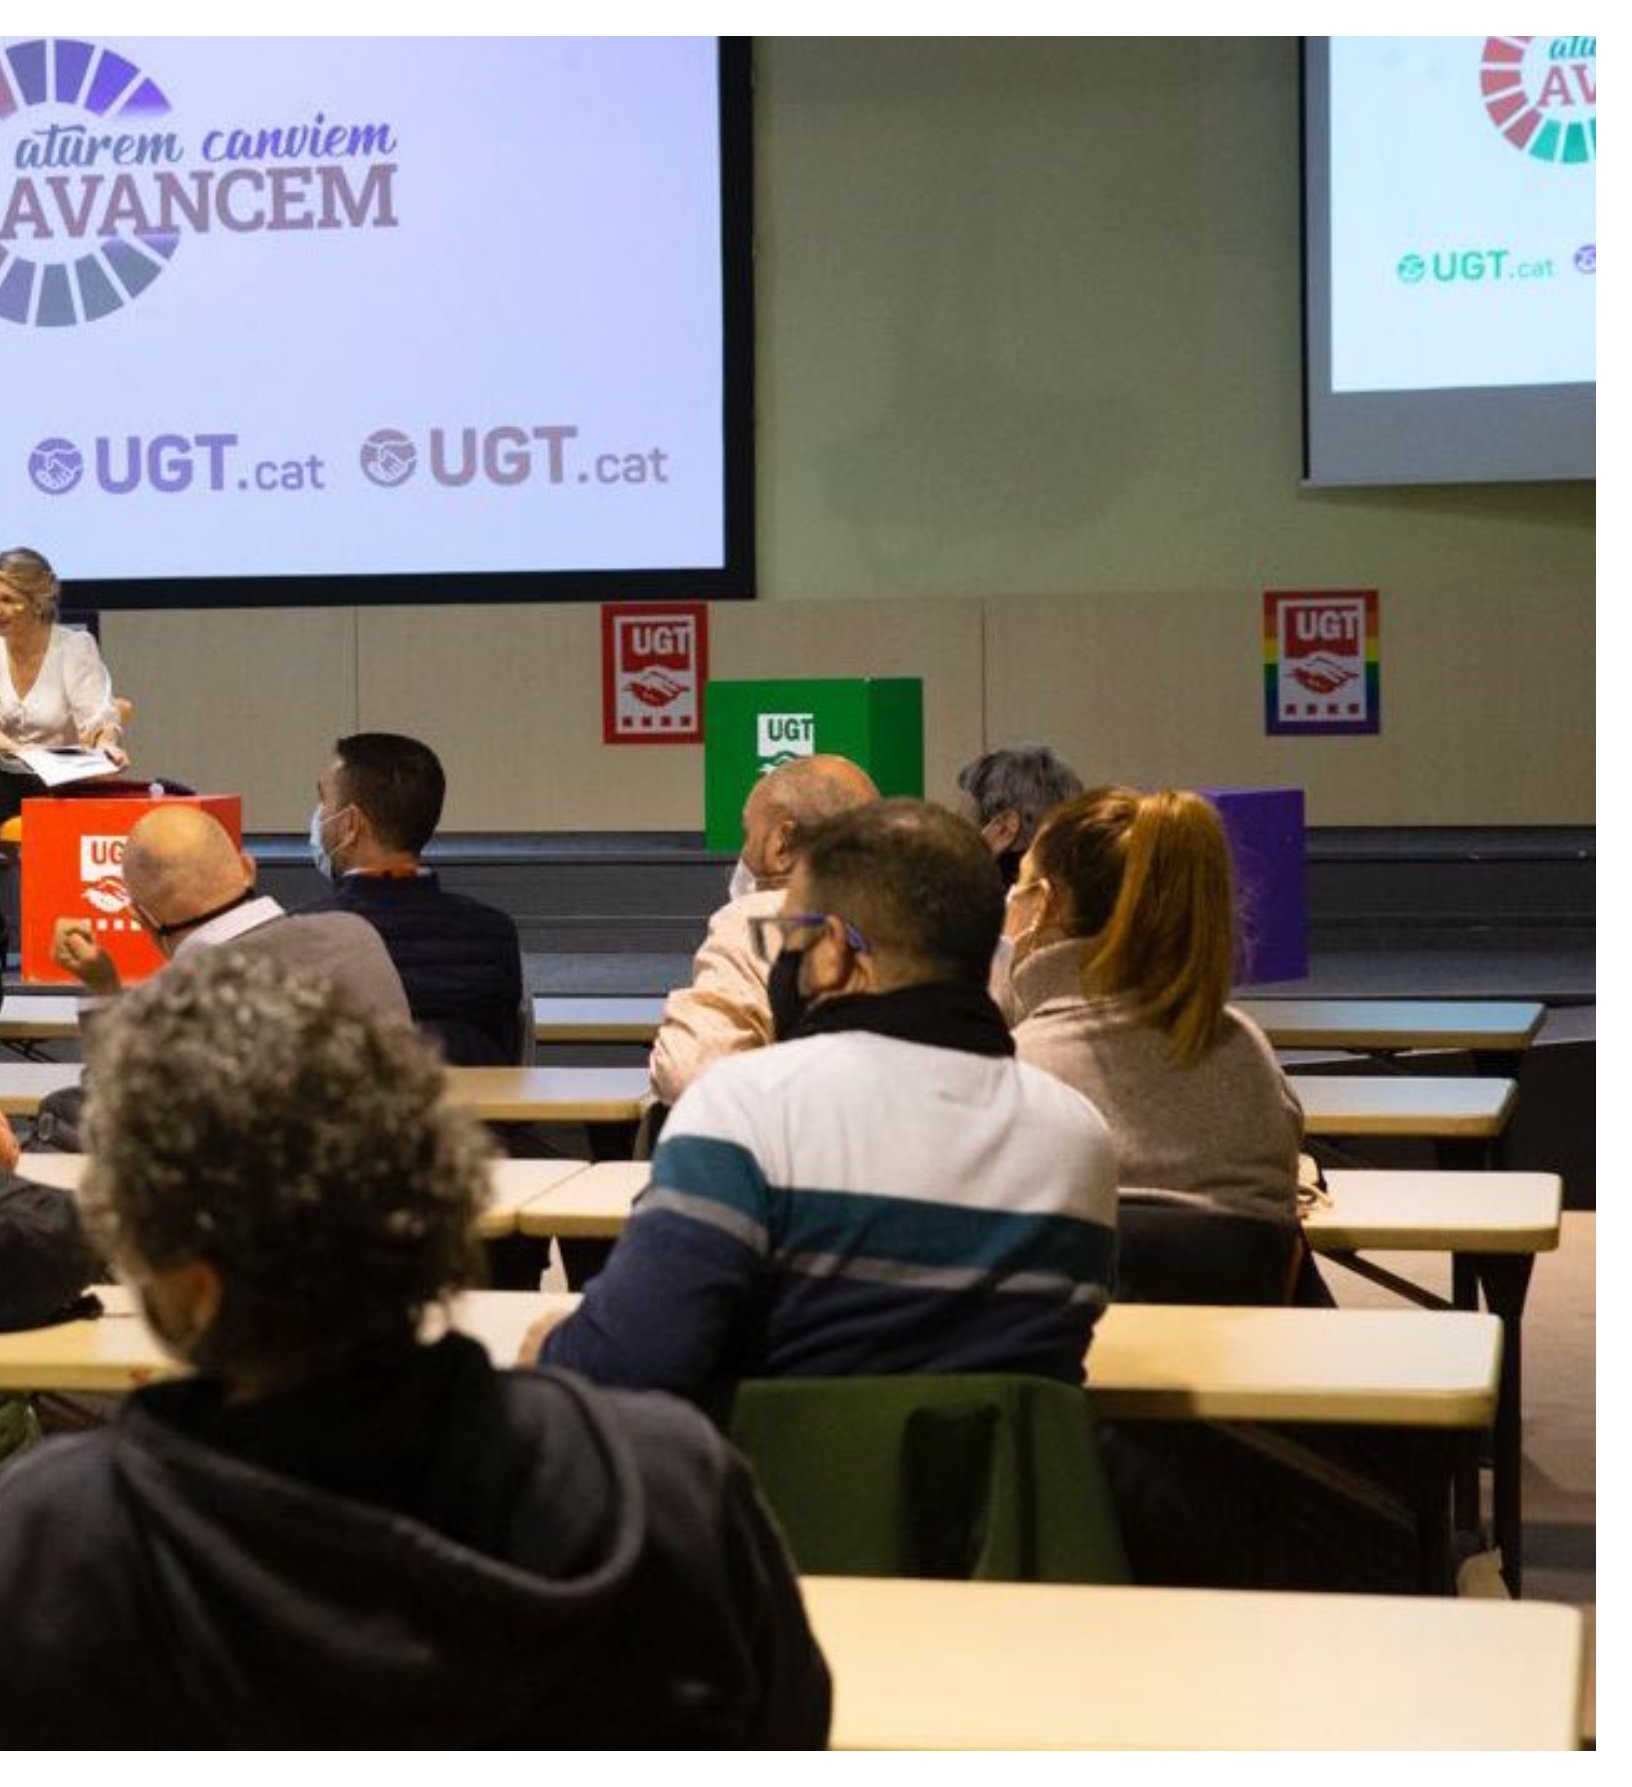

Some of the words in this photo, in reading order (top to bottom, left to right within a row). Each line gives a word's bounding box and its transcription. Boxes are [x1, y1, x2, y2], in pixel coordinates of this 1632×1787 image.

[1537, 64, 1596, 107] AV
[16, 124, 184, 169] aturem
[202, 112, 397, 161] canviem
[1432, 249, 1554, 283] UGT.cat
[96, 433, 325, 495] UGT.cat
[429, 425, 669, 488] UGT.cat
[632, 625, 689, 656] UGT
[1296, 609, 1357, 640] UGT
[767, 718, 813, 742] UGT
[90, 840, 126, 865] UG
